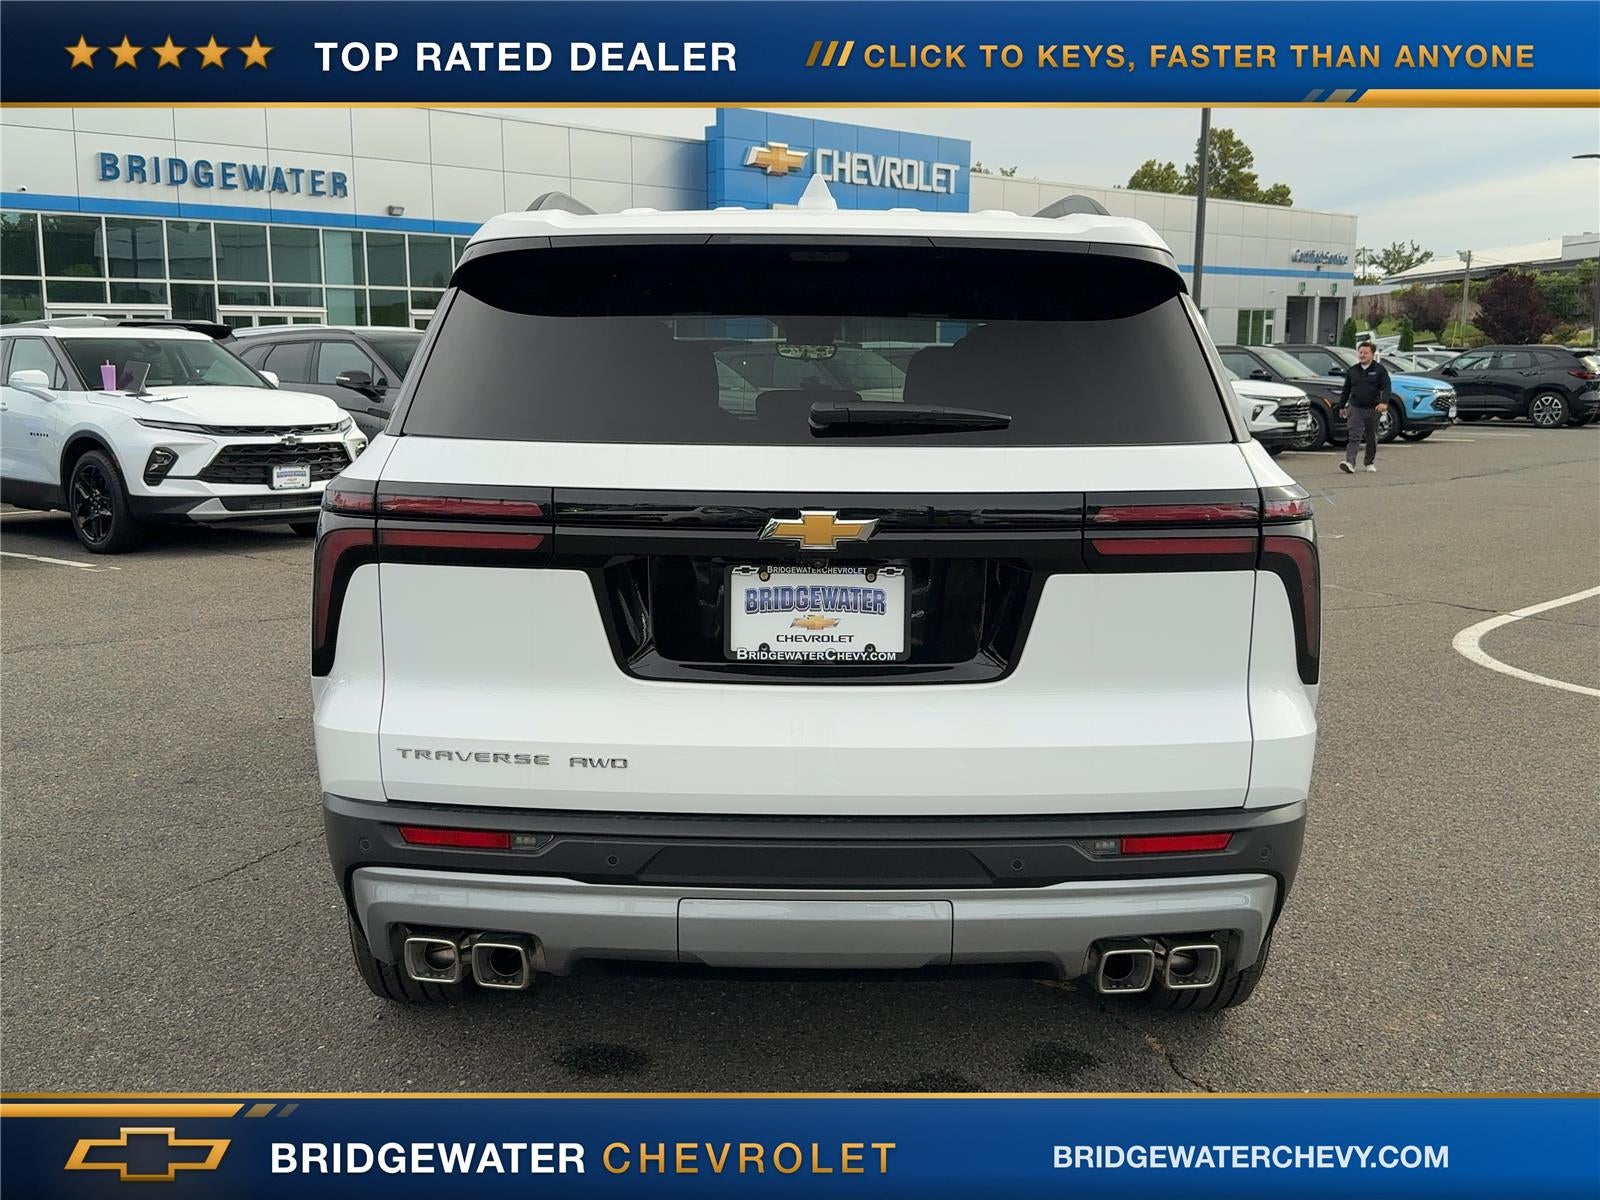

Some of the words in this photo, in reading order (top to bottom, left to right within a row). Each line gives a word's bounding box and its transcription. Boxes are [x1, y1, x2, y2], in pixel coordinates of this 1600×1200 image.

[98, 151, 348, 198] BRIDGEWATER
[815, 148, 960, 194] CHEVROLET
[744, 585, 887, 615] BRIDGEWATER
[776, 634, 855, 643] CHEVROLET
[396, 748, 551, 766] TRAVERSE
[569, 757, 628, 769] AWD
